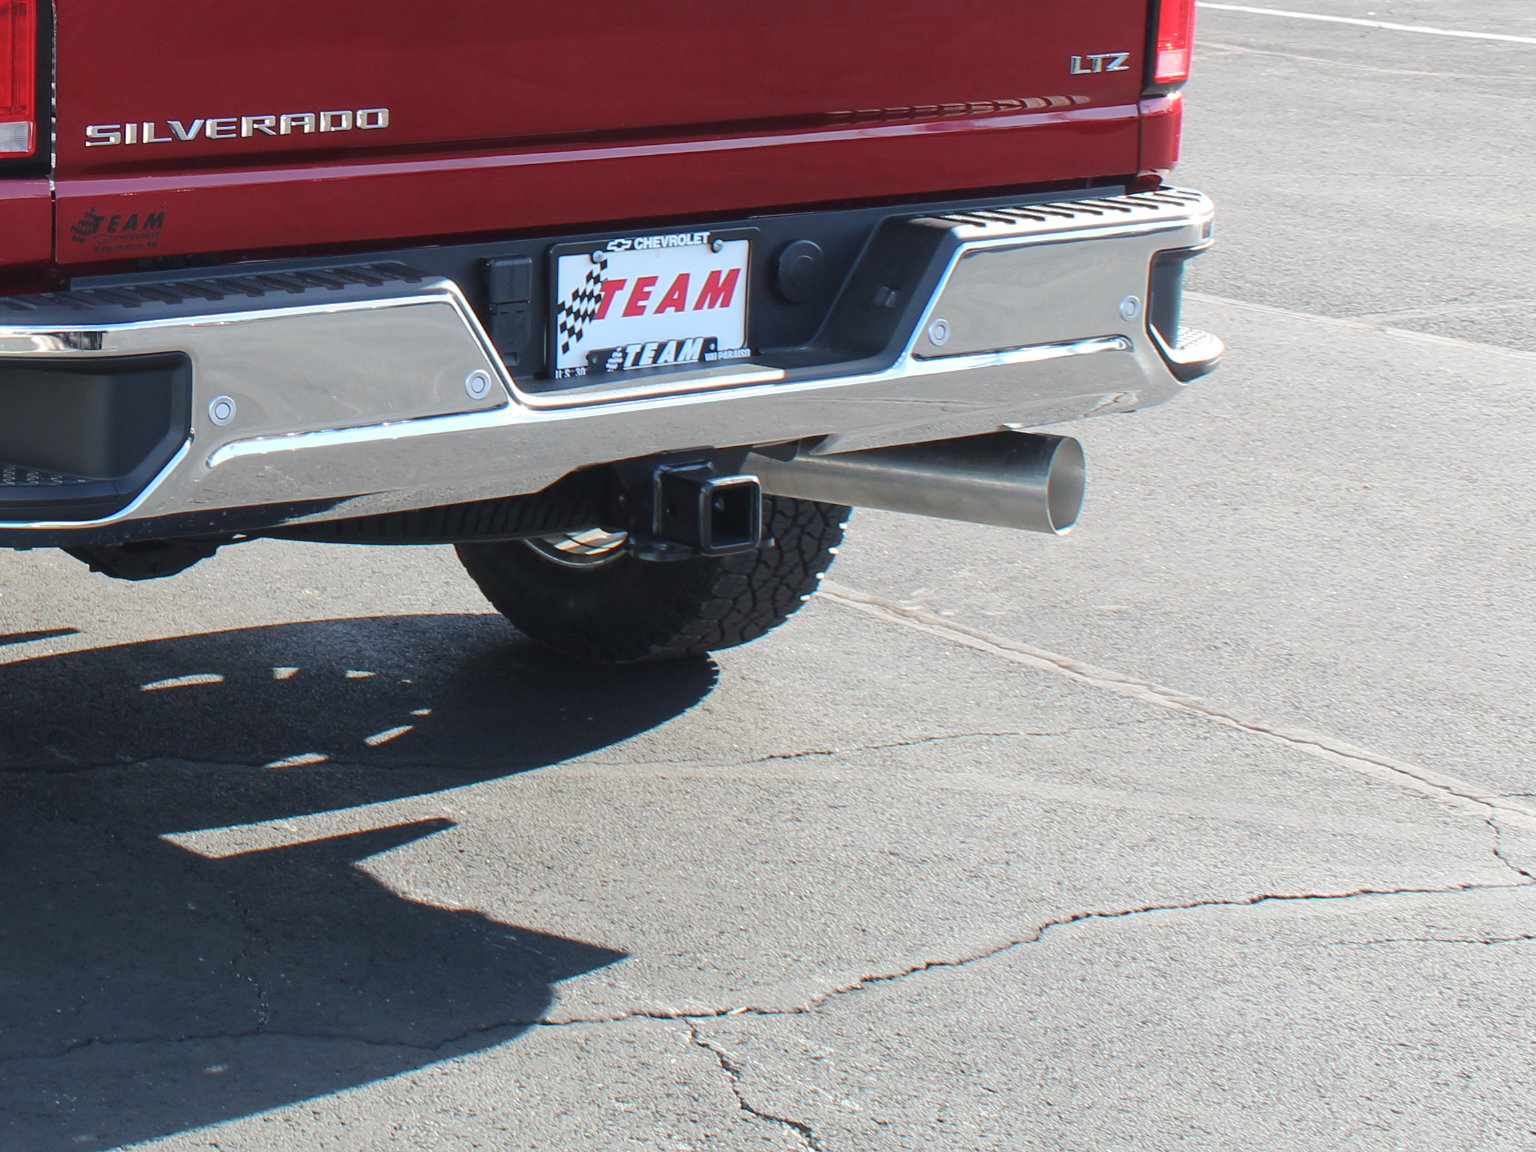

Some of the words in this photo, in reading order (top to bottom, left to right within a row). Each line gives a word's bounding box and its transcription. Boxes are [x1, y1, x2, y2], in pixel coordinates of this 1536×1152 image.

[1070, 51, 1131, 75] LTZ
[84, 108, 390, 147] SILVERADO
[91, 211, 166, 235] TEAM
[633, 232, 710, 250] CHEVROLET
[593, 268, 741, 320] TEAM
[622, 337, 704, 367] TEAM
